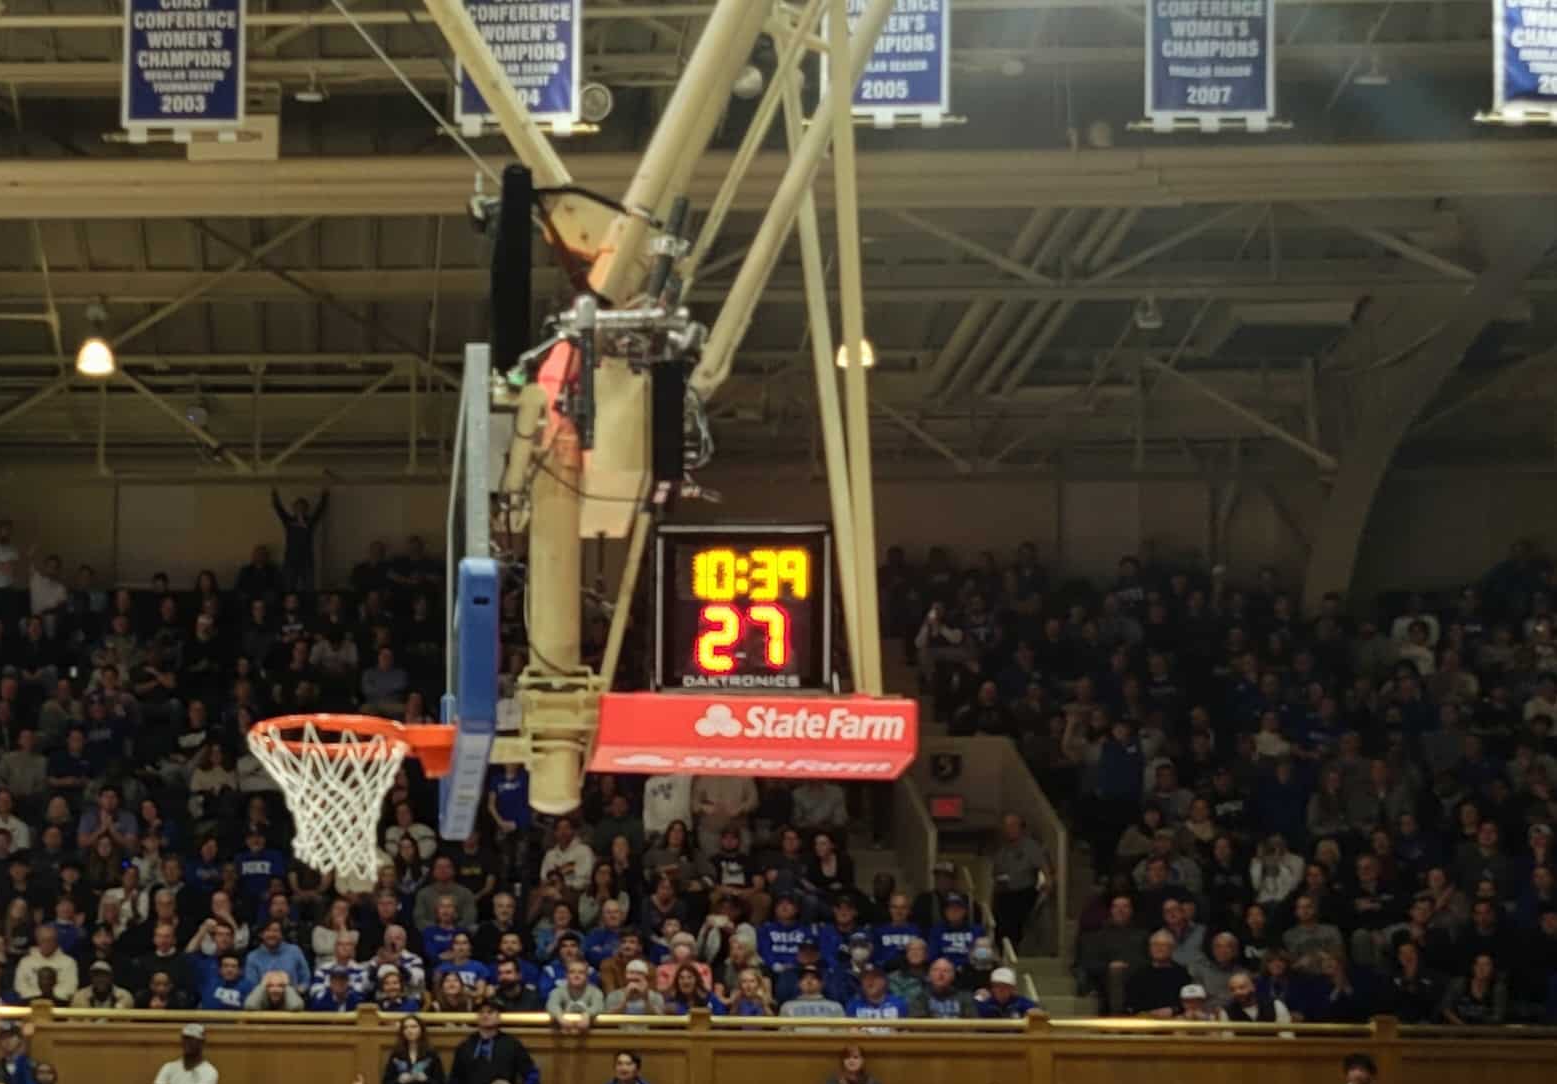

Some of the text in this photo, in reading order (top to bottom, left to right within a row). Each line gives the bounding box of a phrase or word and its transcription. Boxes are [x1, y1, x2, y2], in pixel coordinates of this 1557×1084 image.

[134, 11, 237, 29] CONFERENCE
[1169, 19, 1250, 38] WOMEN'S
[146, 31, 223, 49] WOMEN'S
[1162, 39, 1260, 58] CHAMPIONS
[136, 50, 232, 69] CHAMPIONS
[861, 79, 909, 99] 2005
[1186, 85, 1233, 105] 2007
[160, 95, 207, 113] 2003
[693, 549, 808, 601] 10:39
[696, 604, 789, 672] 27
[682, 674, 801, 688] DAKTRONICS
